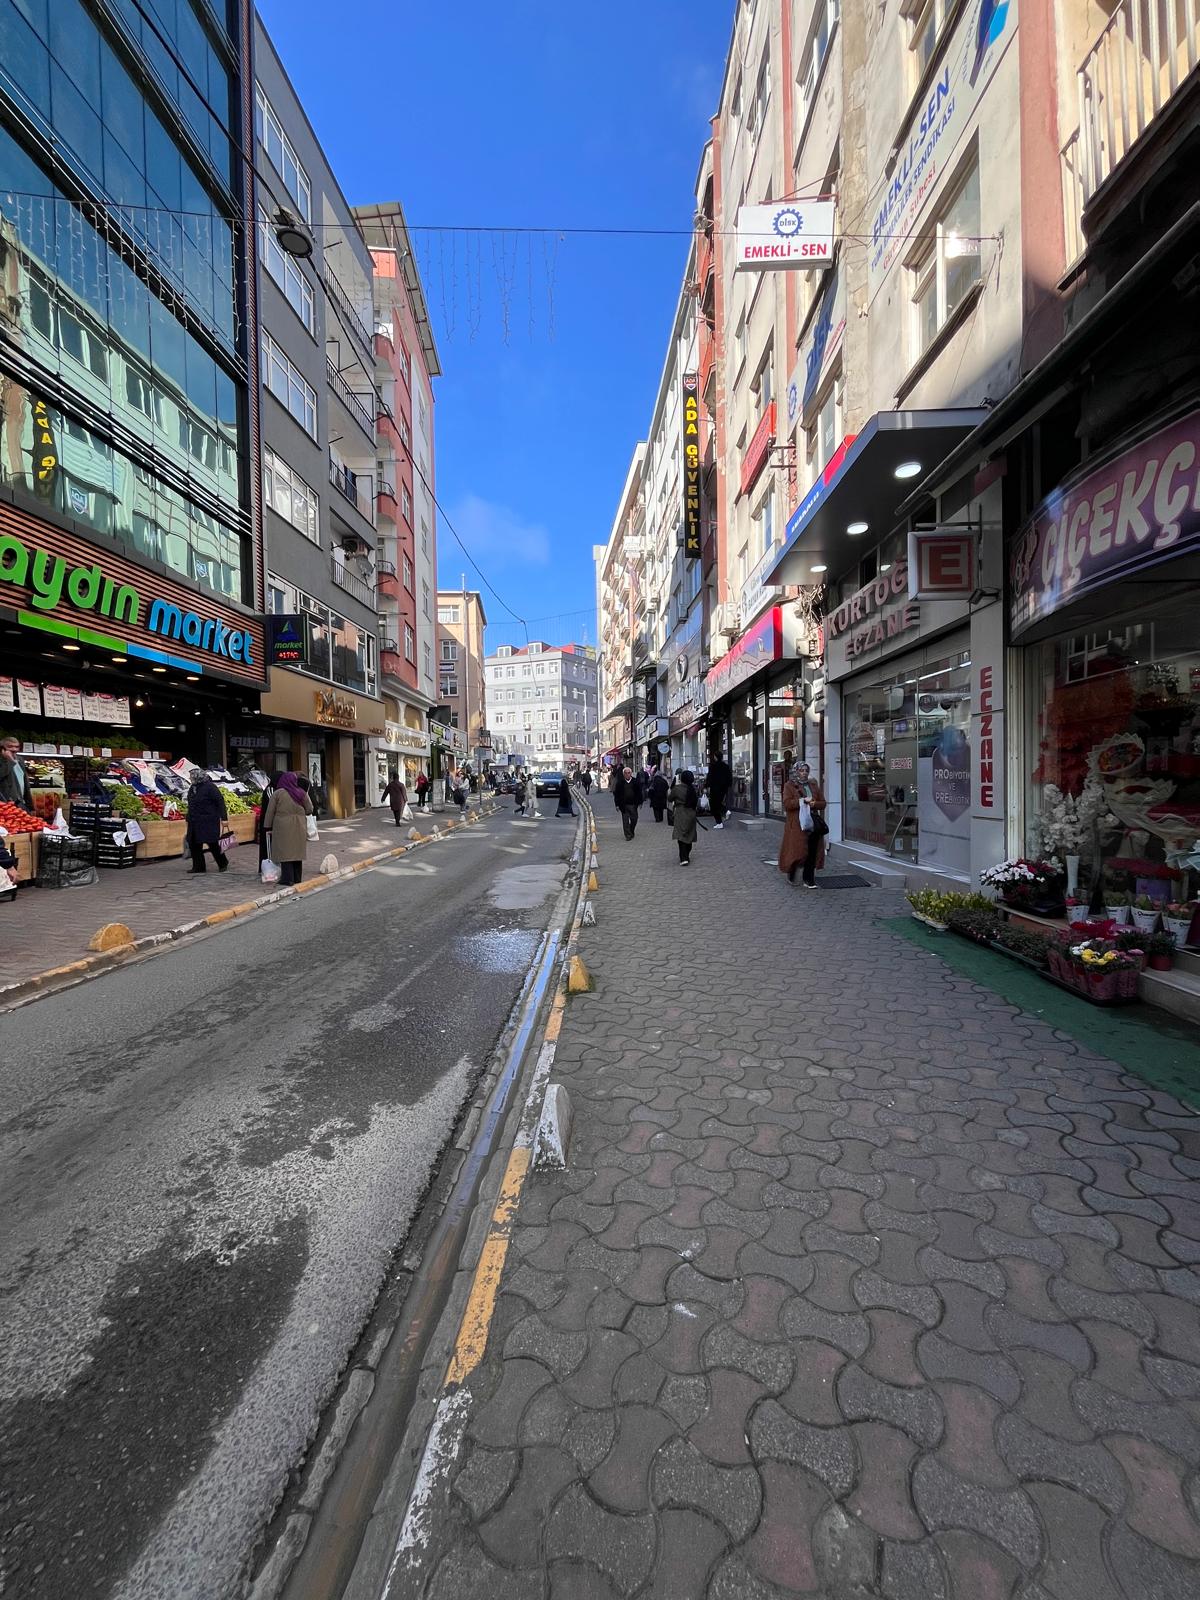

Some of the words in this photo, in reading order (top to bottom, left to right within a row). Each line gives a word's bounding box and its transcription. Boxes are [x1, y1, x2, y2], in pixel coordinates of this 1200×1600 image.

[744, 241, 791, 259] EMEKLİ
[801, 243, 827, 256] SEN
[686, 396, 698, 434] ADA
[686, 444, 700, 549] GÜVENLİK
[929, 545, 963, 585] E
[149, 598, 254, 665] market
[274, 641, 304, 650] market
[844, 603, 917, 662] ECZANE
[980, 666, 994, 808] ECZANE
